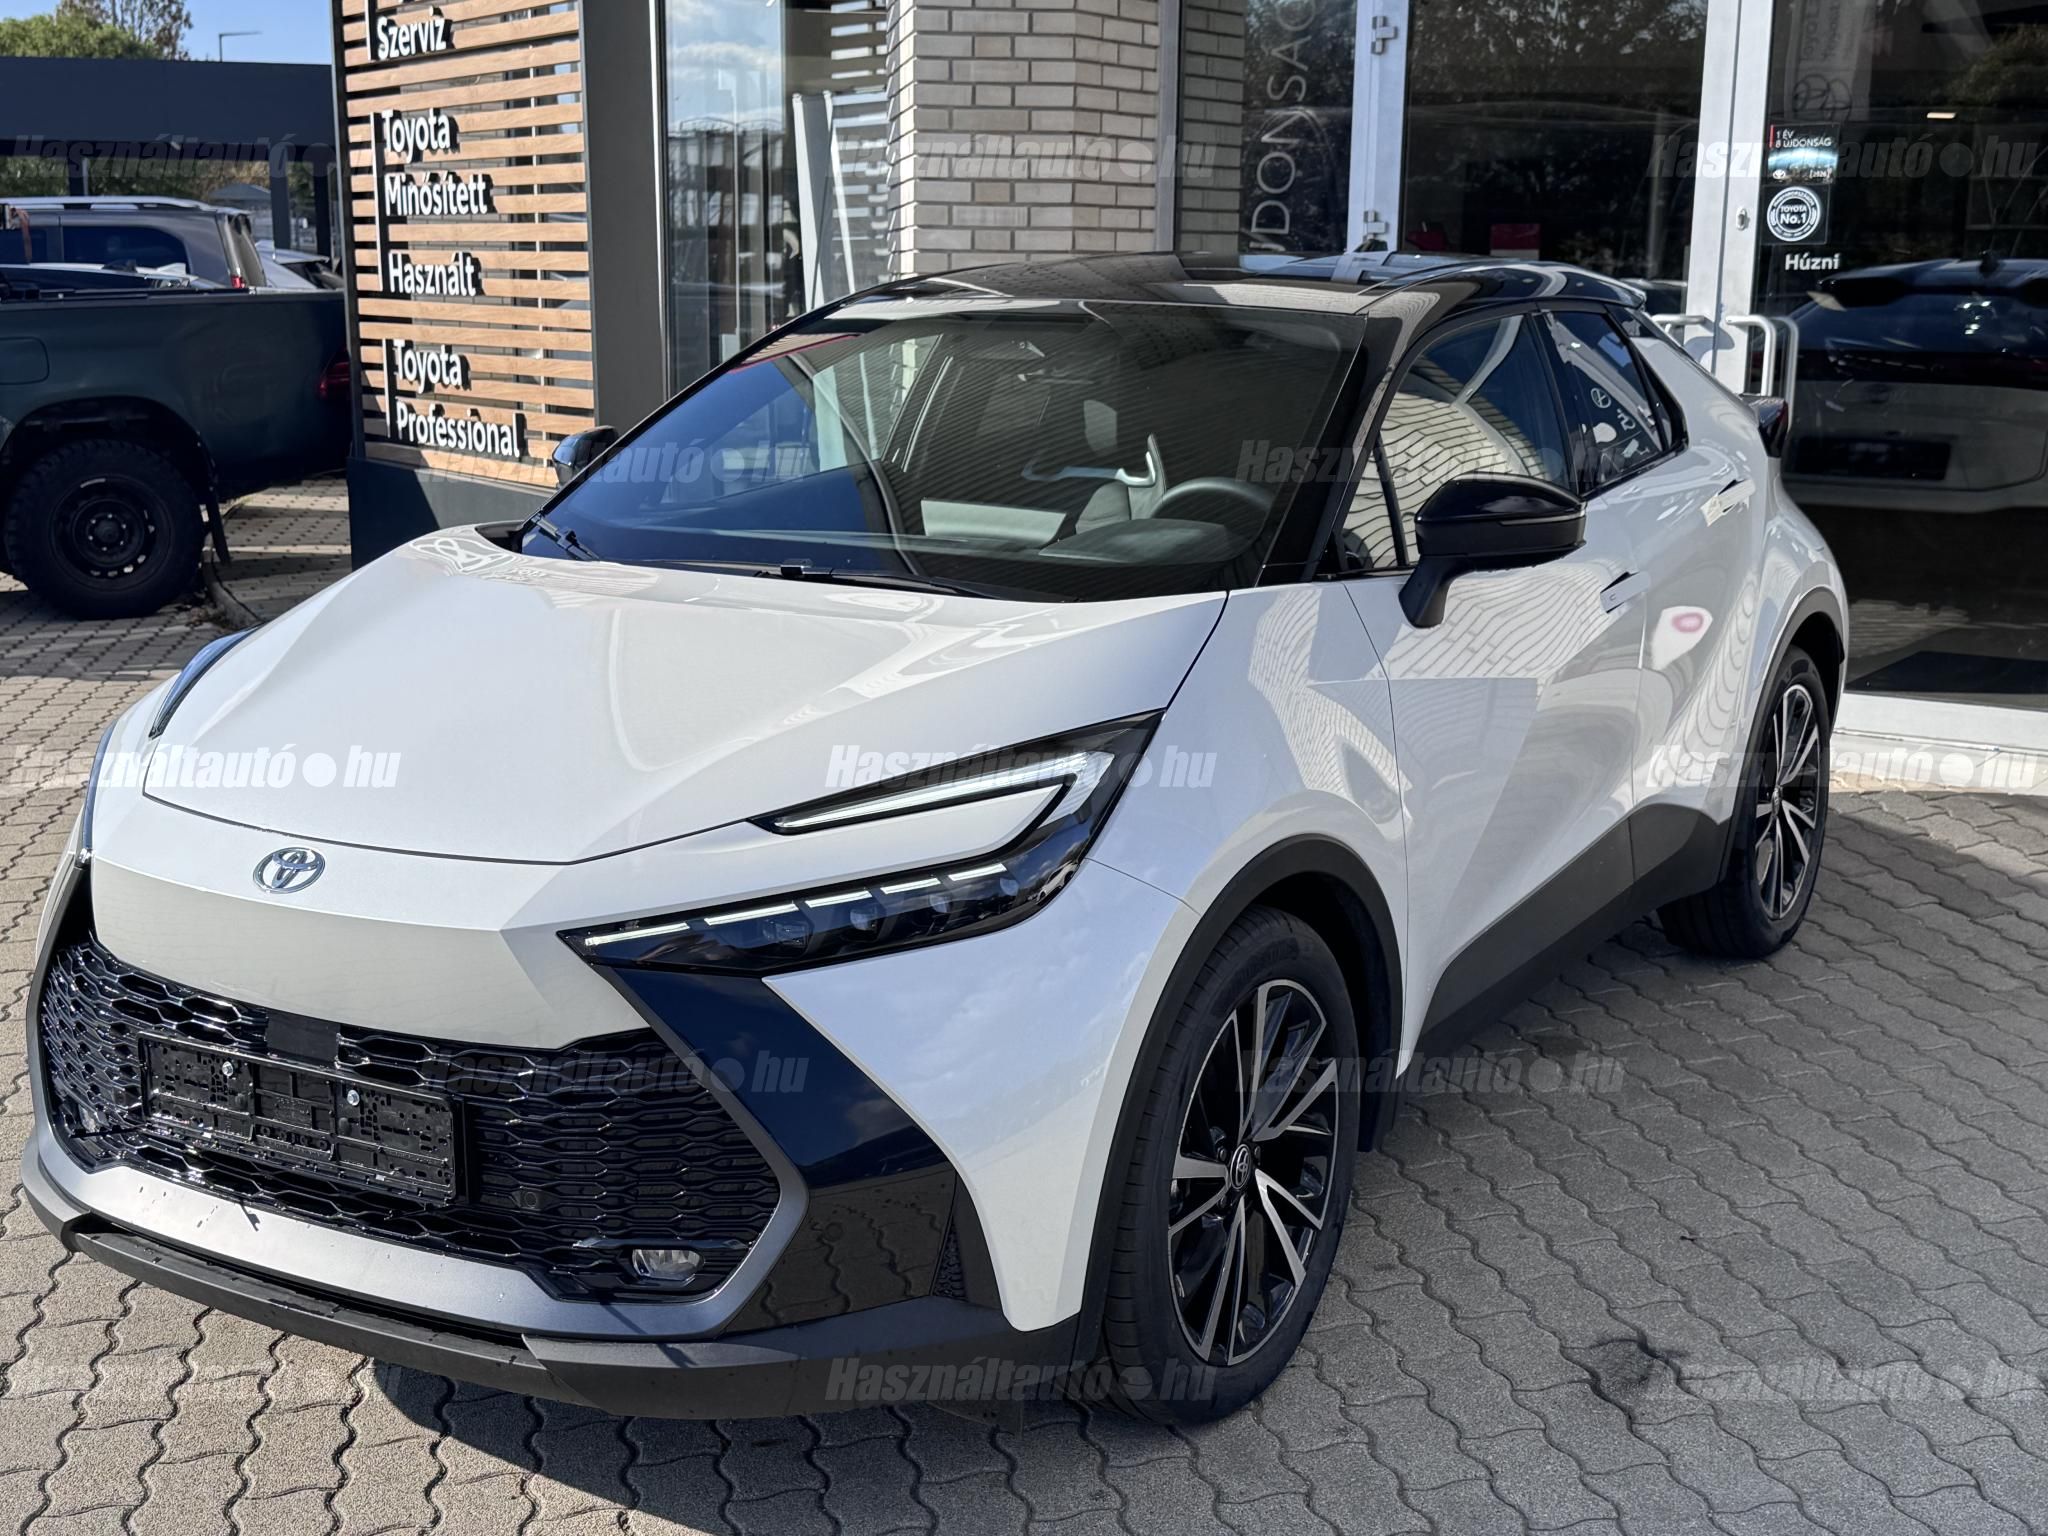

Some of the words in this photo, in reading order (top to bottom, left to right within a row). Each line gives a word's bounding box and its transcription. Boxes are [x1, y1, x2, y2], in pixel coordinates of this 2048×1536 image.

[377, 6, 447, 60] Szerviz
[382, 107, 451, 164] Toyota
[384, 170, 488, 216] Minősített
[1780, 204, 1808, 213] TOYOTA
[1780, 213, 1807, 225] No.1
[388, 251, 476, 296] Használt
[1785, 253, 1840, 270] Húzni
[393, 338, 463, 393] Toyota
[396, 400, 520, 458] Professional
